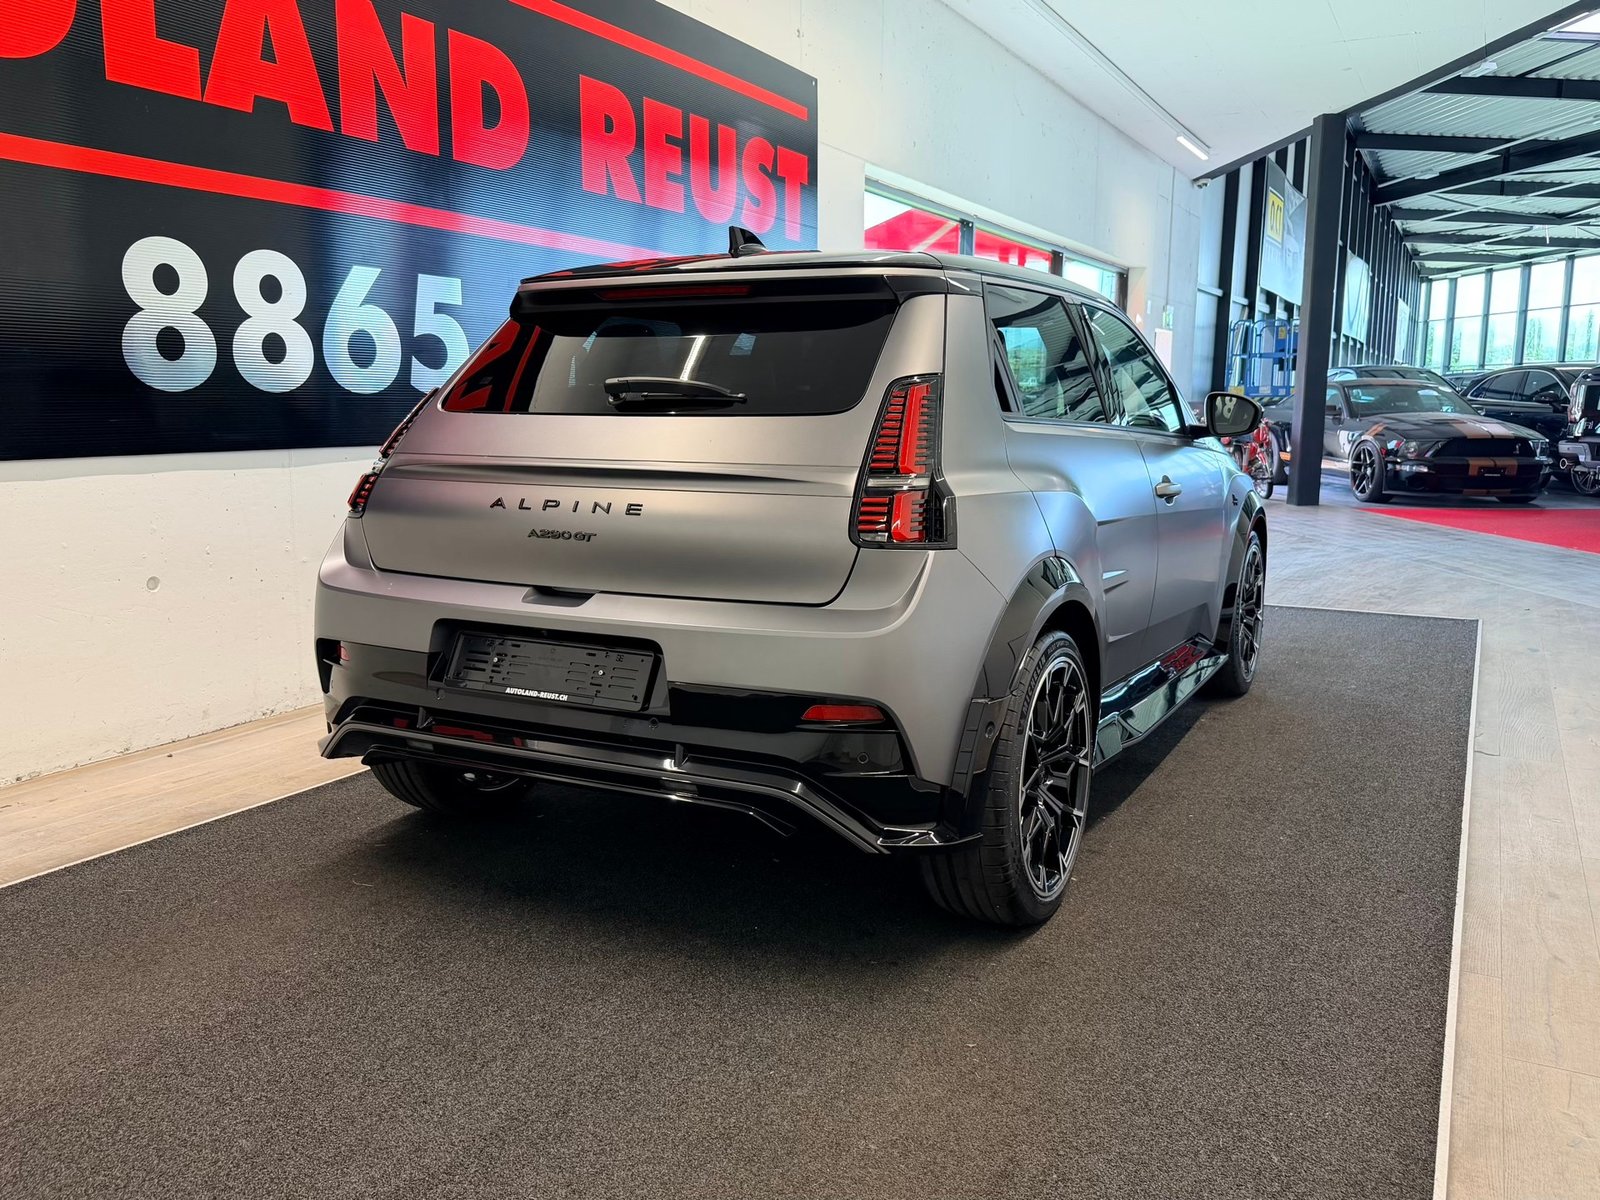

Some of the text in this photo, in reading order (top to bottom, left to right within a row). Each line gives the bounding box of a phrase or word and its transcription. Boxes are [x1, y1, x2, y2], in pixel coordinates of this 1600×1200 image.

[0, 0, 809, 242] LAND REUST
[122, 236, 469, 394] 8865
[489, 496, 643, 516] ALPINE
[505, 687, 568, 702] AUTOLAND-REUST.CH
